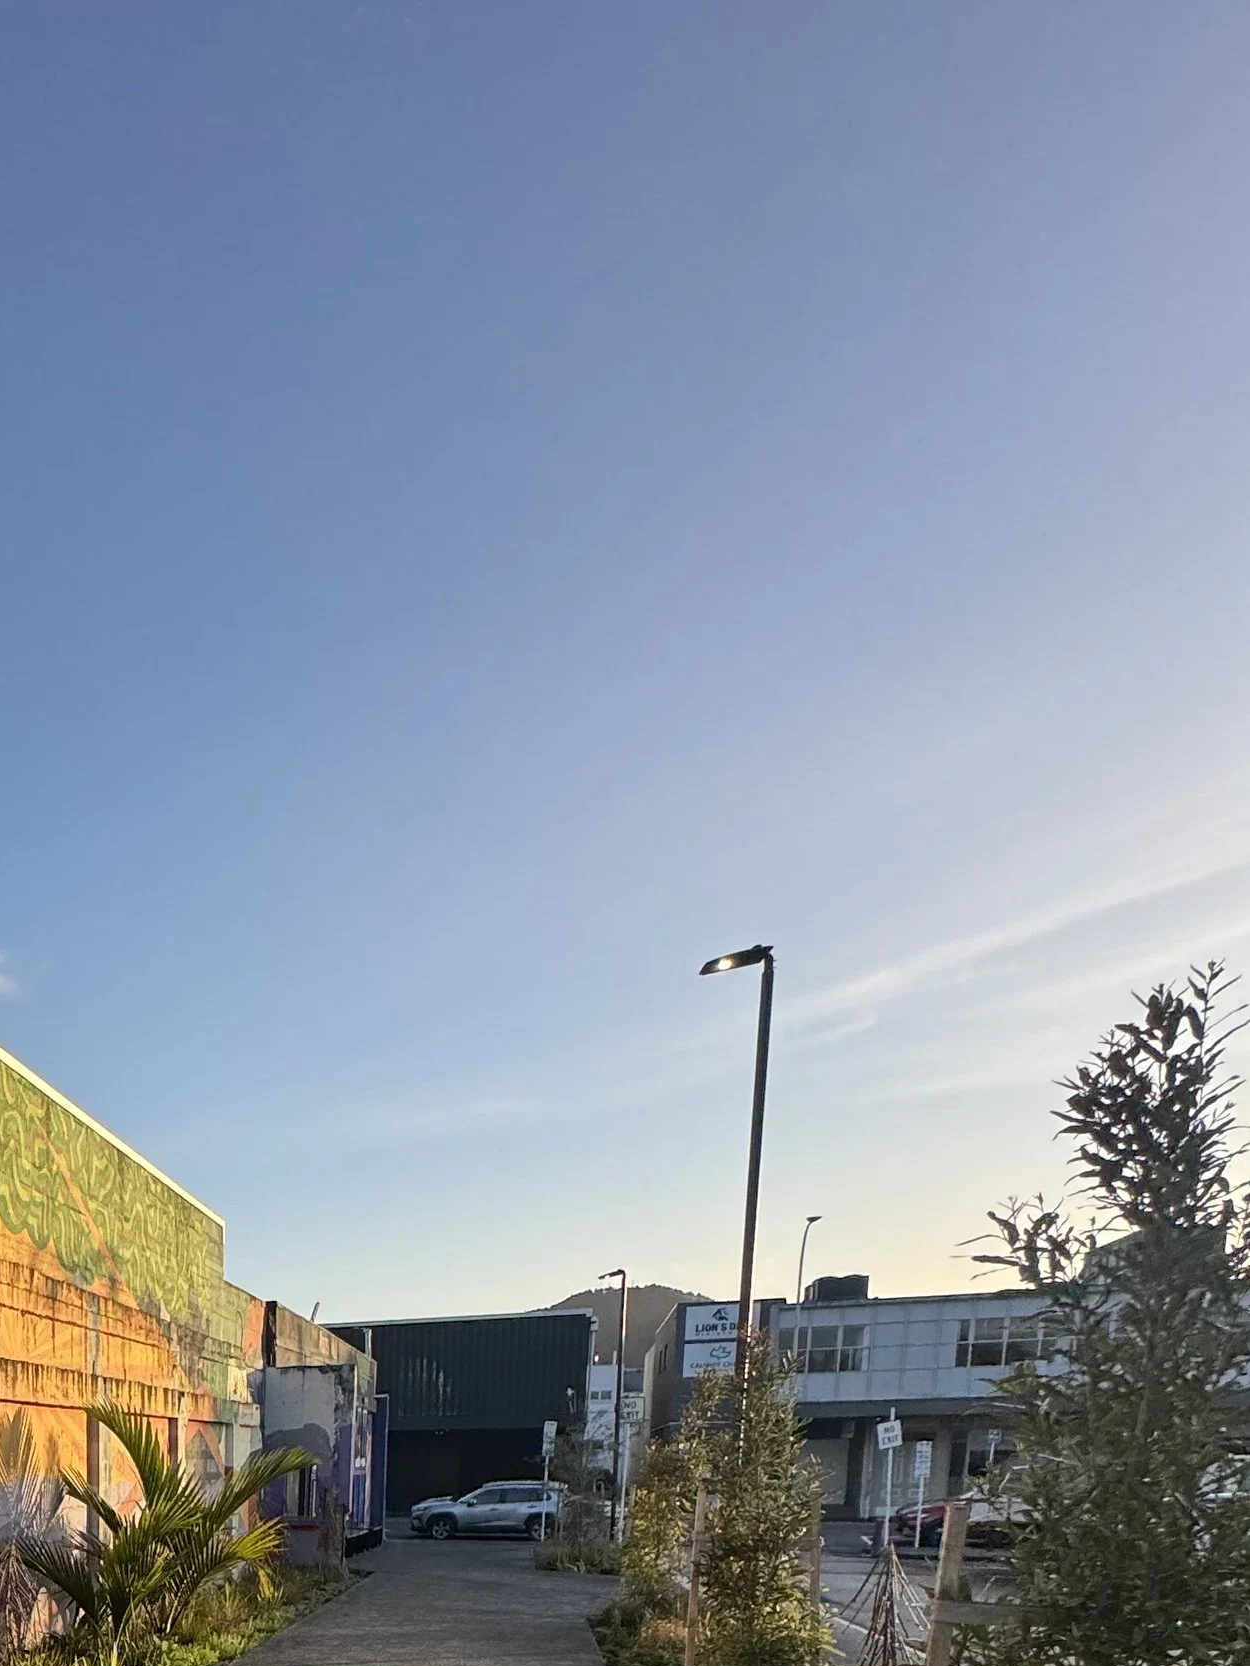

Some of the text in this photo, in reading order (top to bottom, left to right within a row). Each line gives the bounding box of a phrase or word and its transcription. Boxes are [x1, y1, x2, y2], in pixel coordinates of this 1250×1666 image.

[623, 1401, 637, 1409] NO
[883, 1425, 895, 1433] NO
[882, 1435, 899, 1445] EXIT
